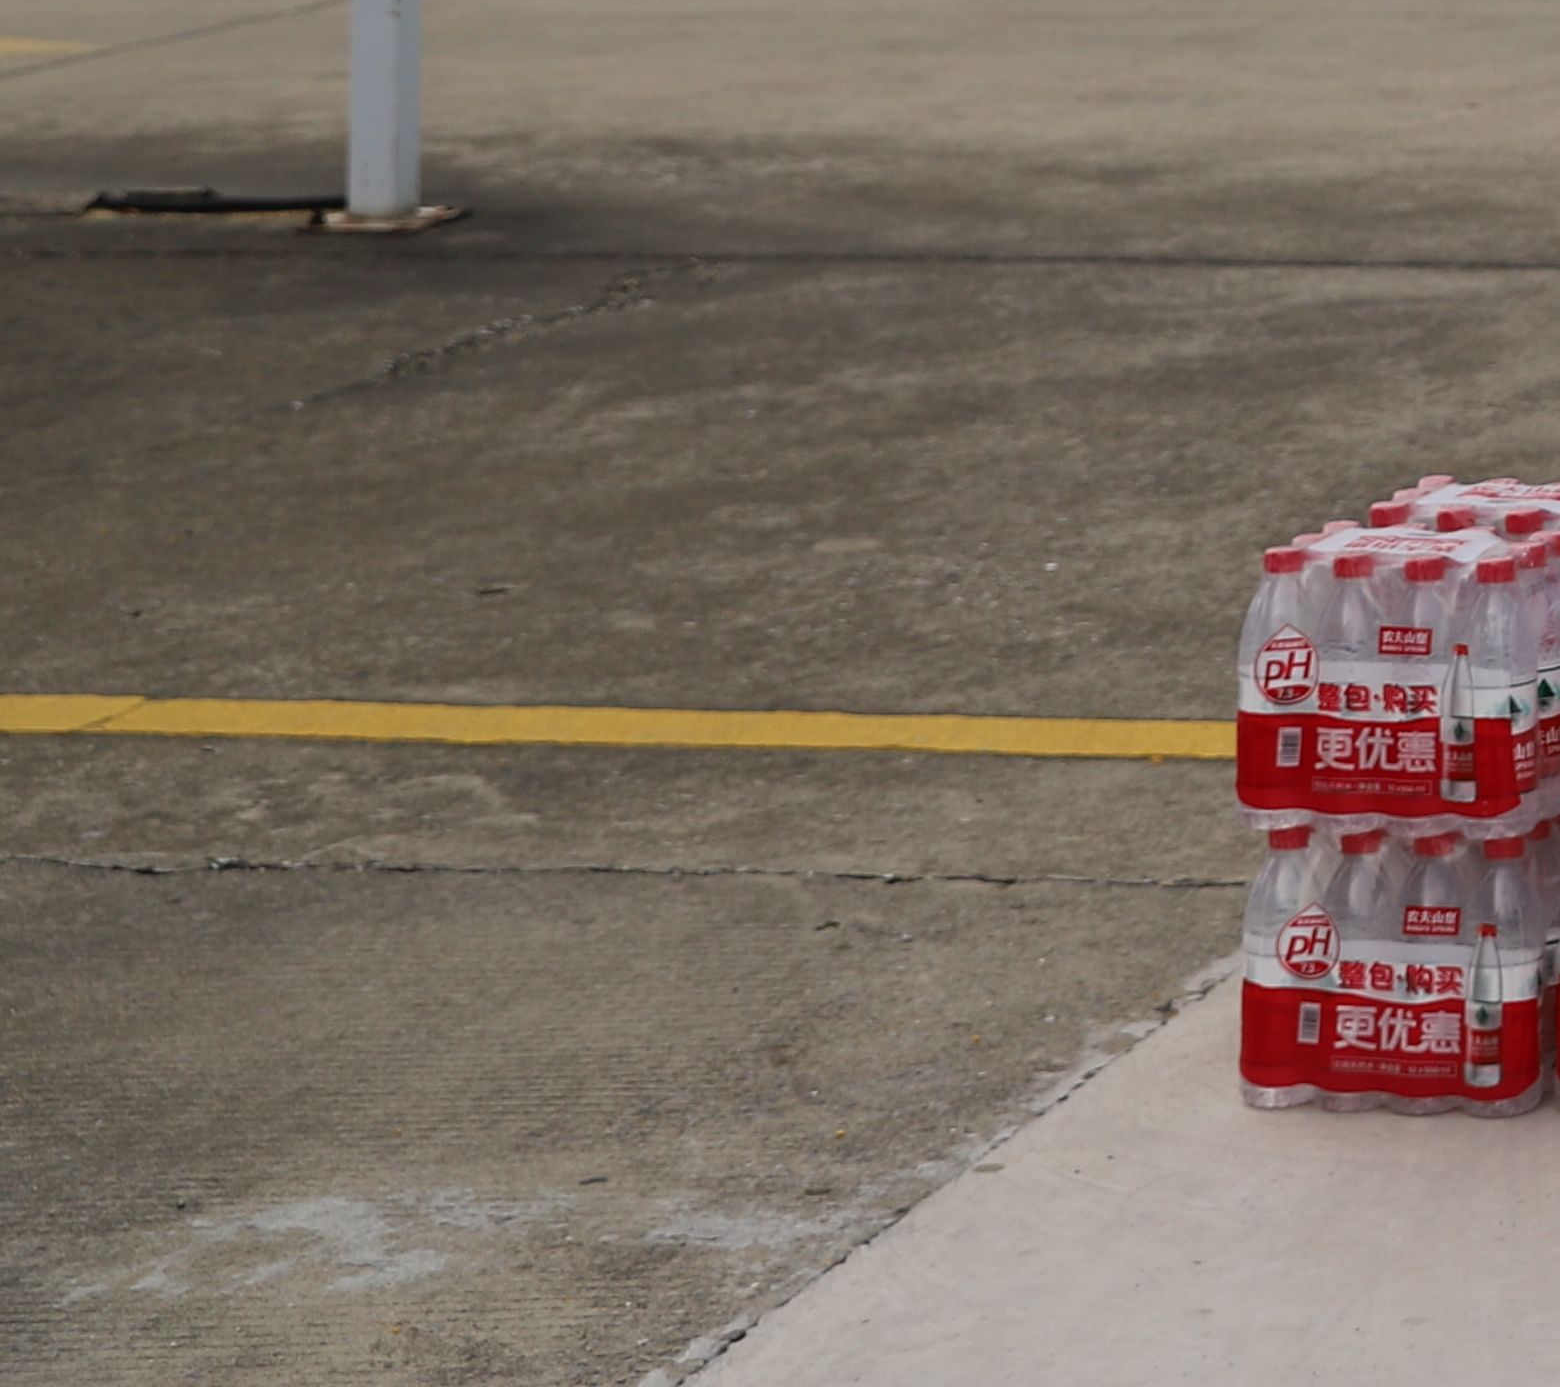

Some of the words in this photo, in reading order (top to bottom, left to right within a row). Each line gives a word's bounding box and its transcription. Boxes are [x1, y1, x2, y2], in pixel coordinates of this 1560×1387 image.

[1264, 651, 1312, 688] pH
[1315, 727, 1436, 772] 更优惠
[1285, 928, 1332, 961] pH
[1333, 1005, 1460, 1054] 更优惠
